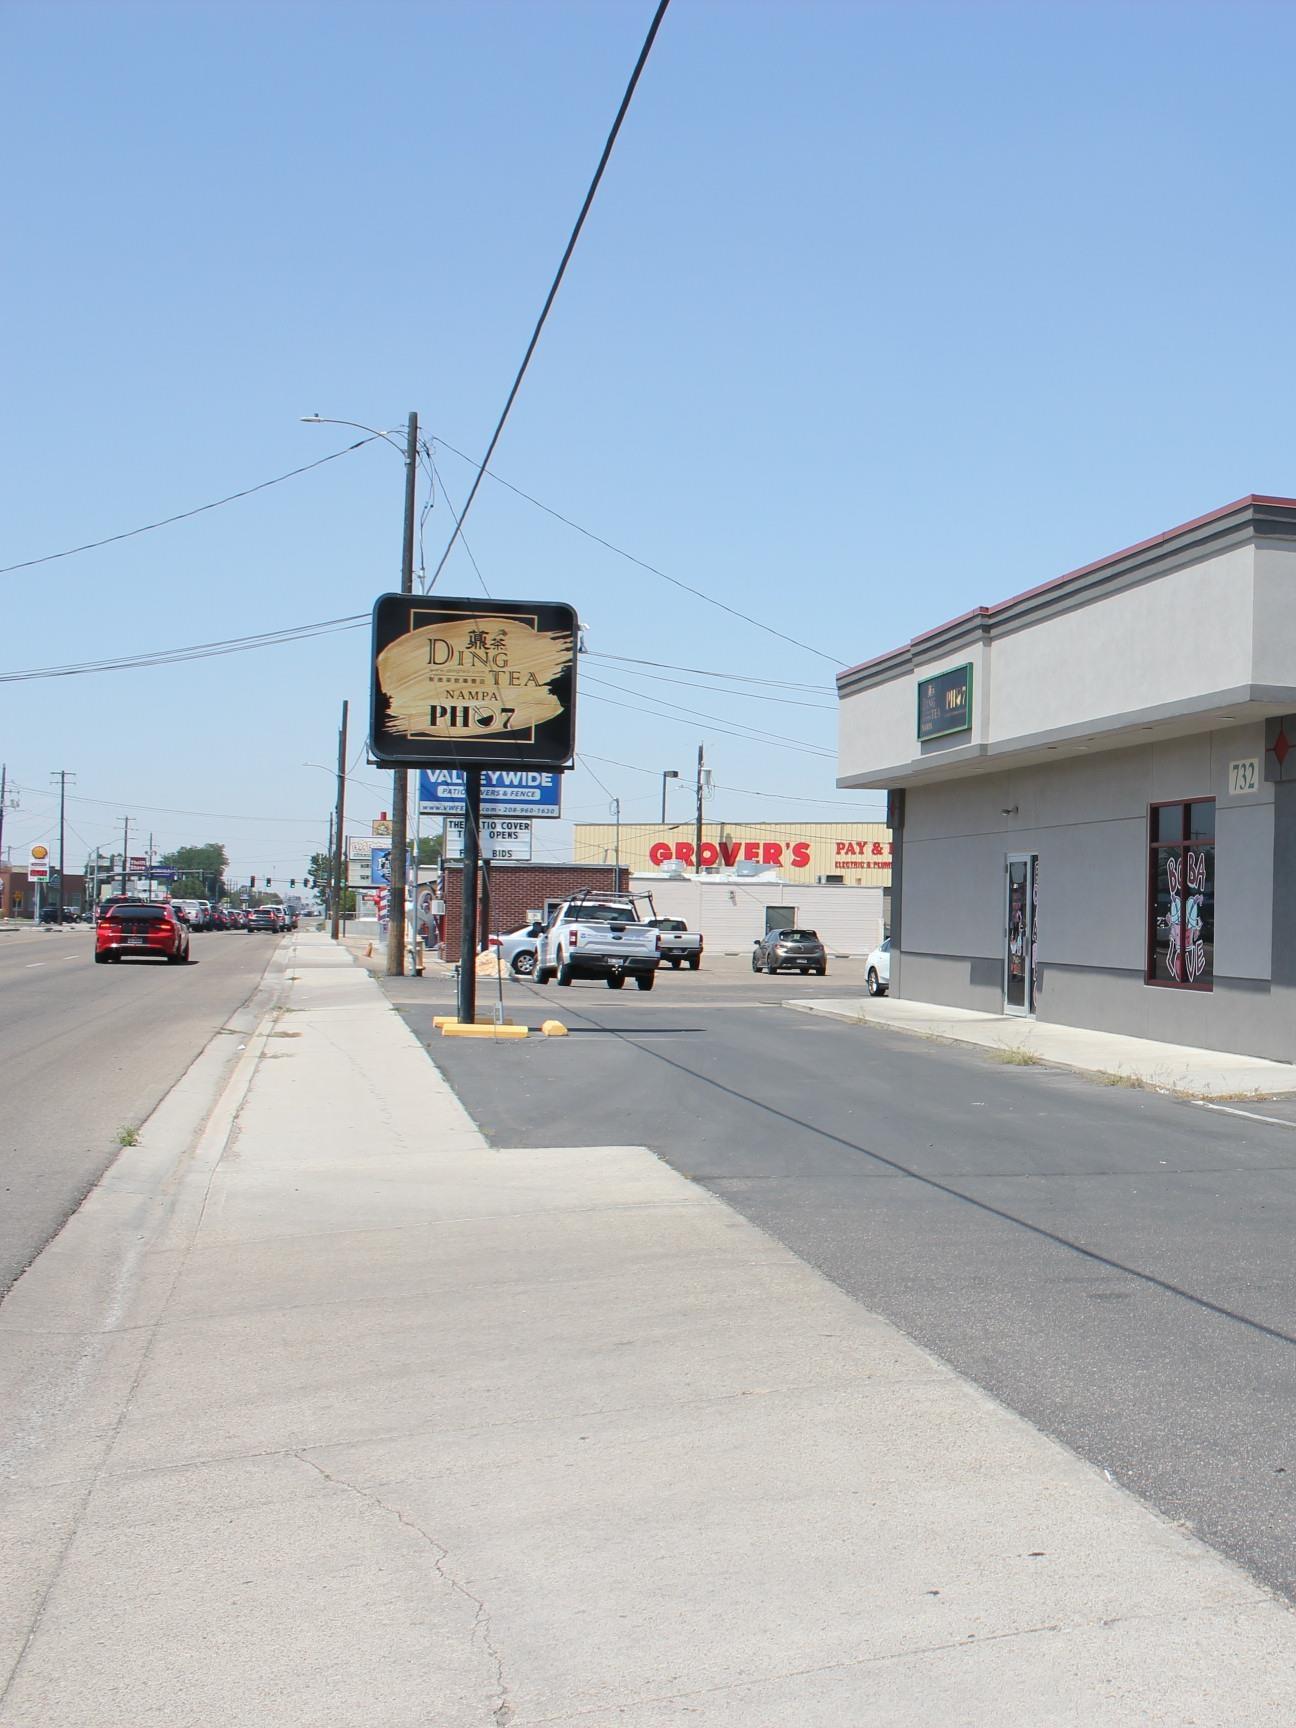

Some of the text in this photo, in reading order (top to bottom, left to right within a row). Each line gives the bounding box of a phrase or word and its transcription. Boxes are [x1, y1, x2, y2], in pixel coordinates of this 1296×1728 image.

[427, 638, 509, 668] DING
[489, 670, 540, 687] TEA
[445, 689, 499, 701] NAMPA
[426, 769, 553, 786] VALEYWIDE
[1232, 762, 1255, 791] 732
[510, 790, 537, 798] FENCE
[500, 822, 530, 831] COVER
[489, 831, 518, 839] OPENS
[492, 850, 513, 858] BIDS
[650, 841, 811, 869] GROVER'S
[836, 841, 867, 855] PAY
[872, 841, 884, 855] &
